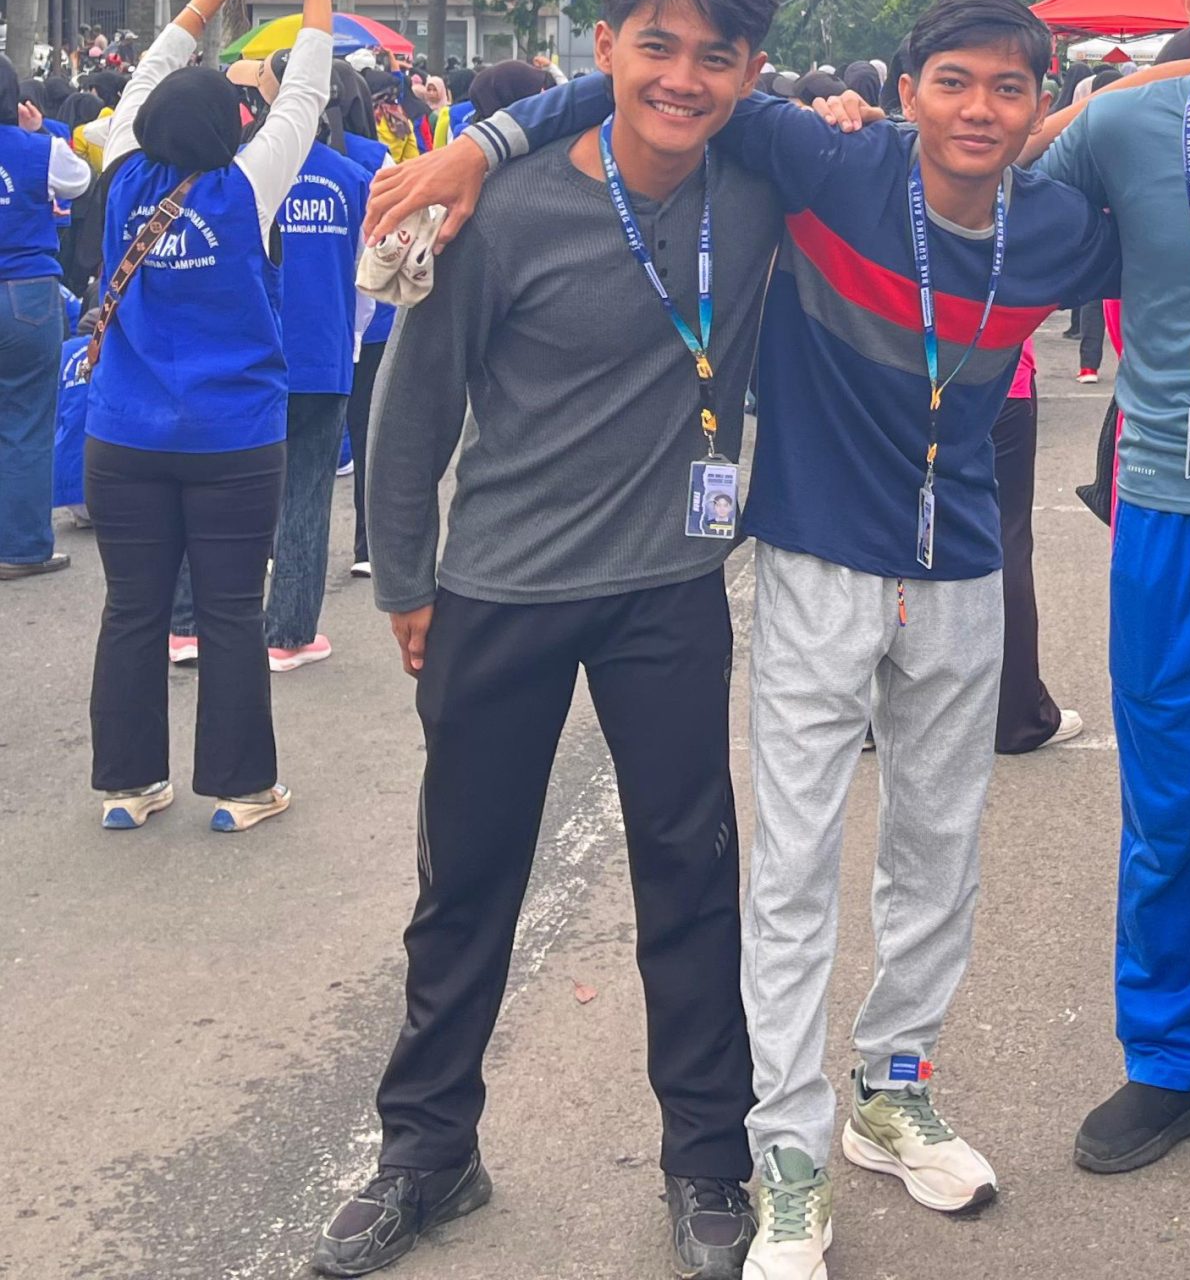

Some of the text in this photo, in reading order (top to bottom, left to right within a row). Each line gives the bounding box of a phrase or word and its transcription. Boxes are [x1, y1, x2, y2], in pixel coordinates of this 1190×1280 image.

[285, 197, 335, 223] (SAPA)
[610, 181, 630, 223] GUNUNG
[912, 191, 922, 215] SARI
[286, 224, 317, 234] BANDAR
[915, 220, 927, 260] GUNUNG
[168, 255, 216, 270] LAMPUNG
